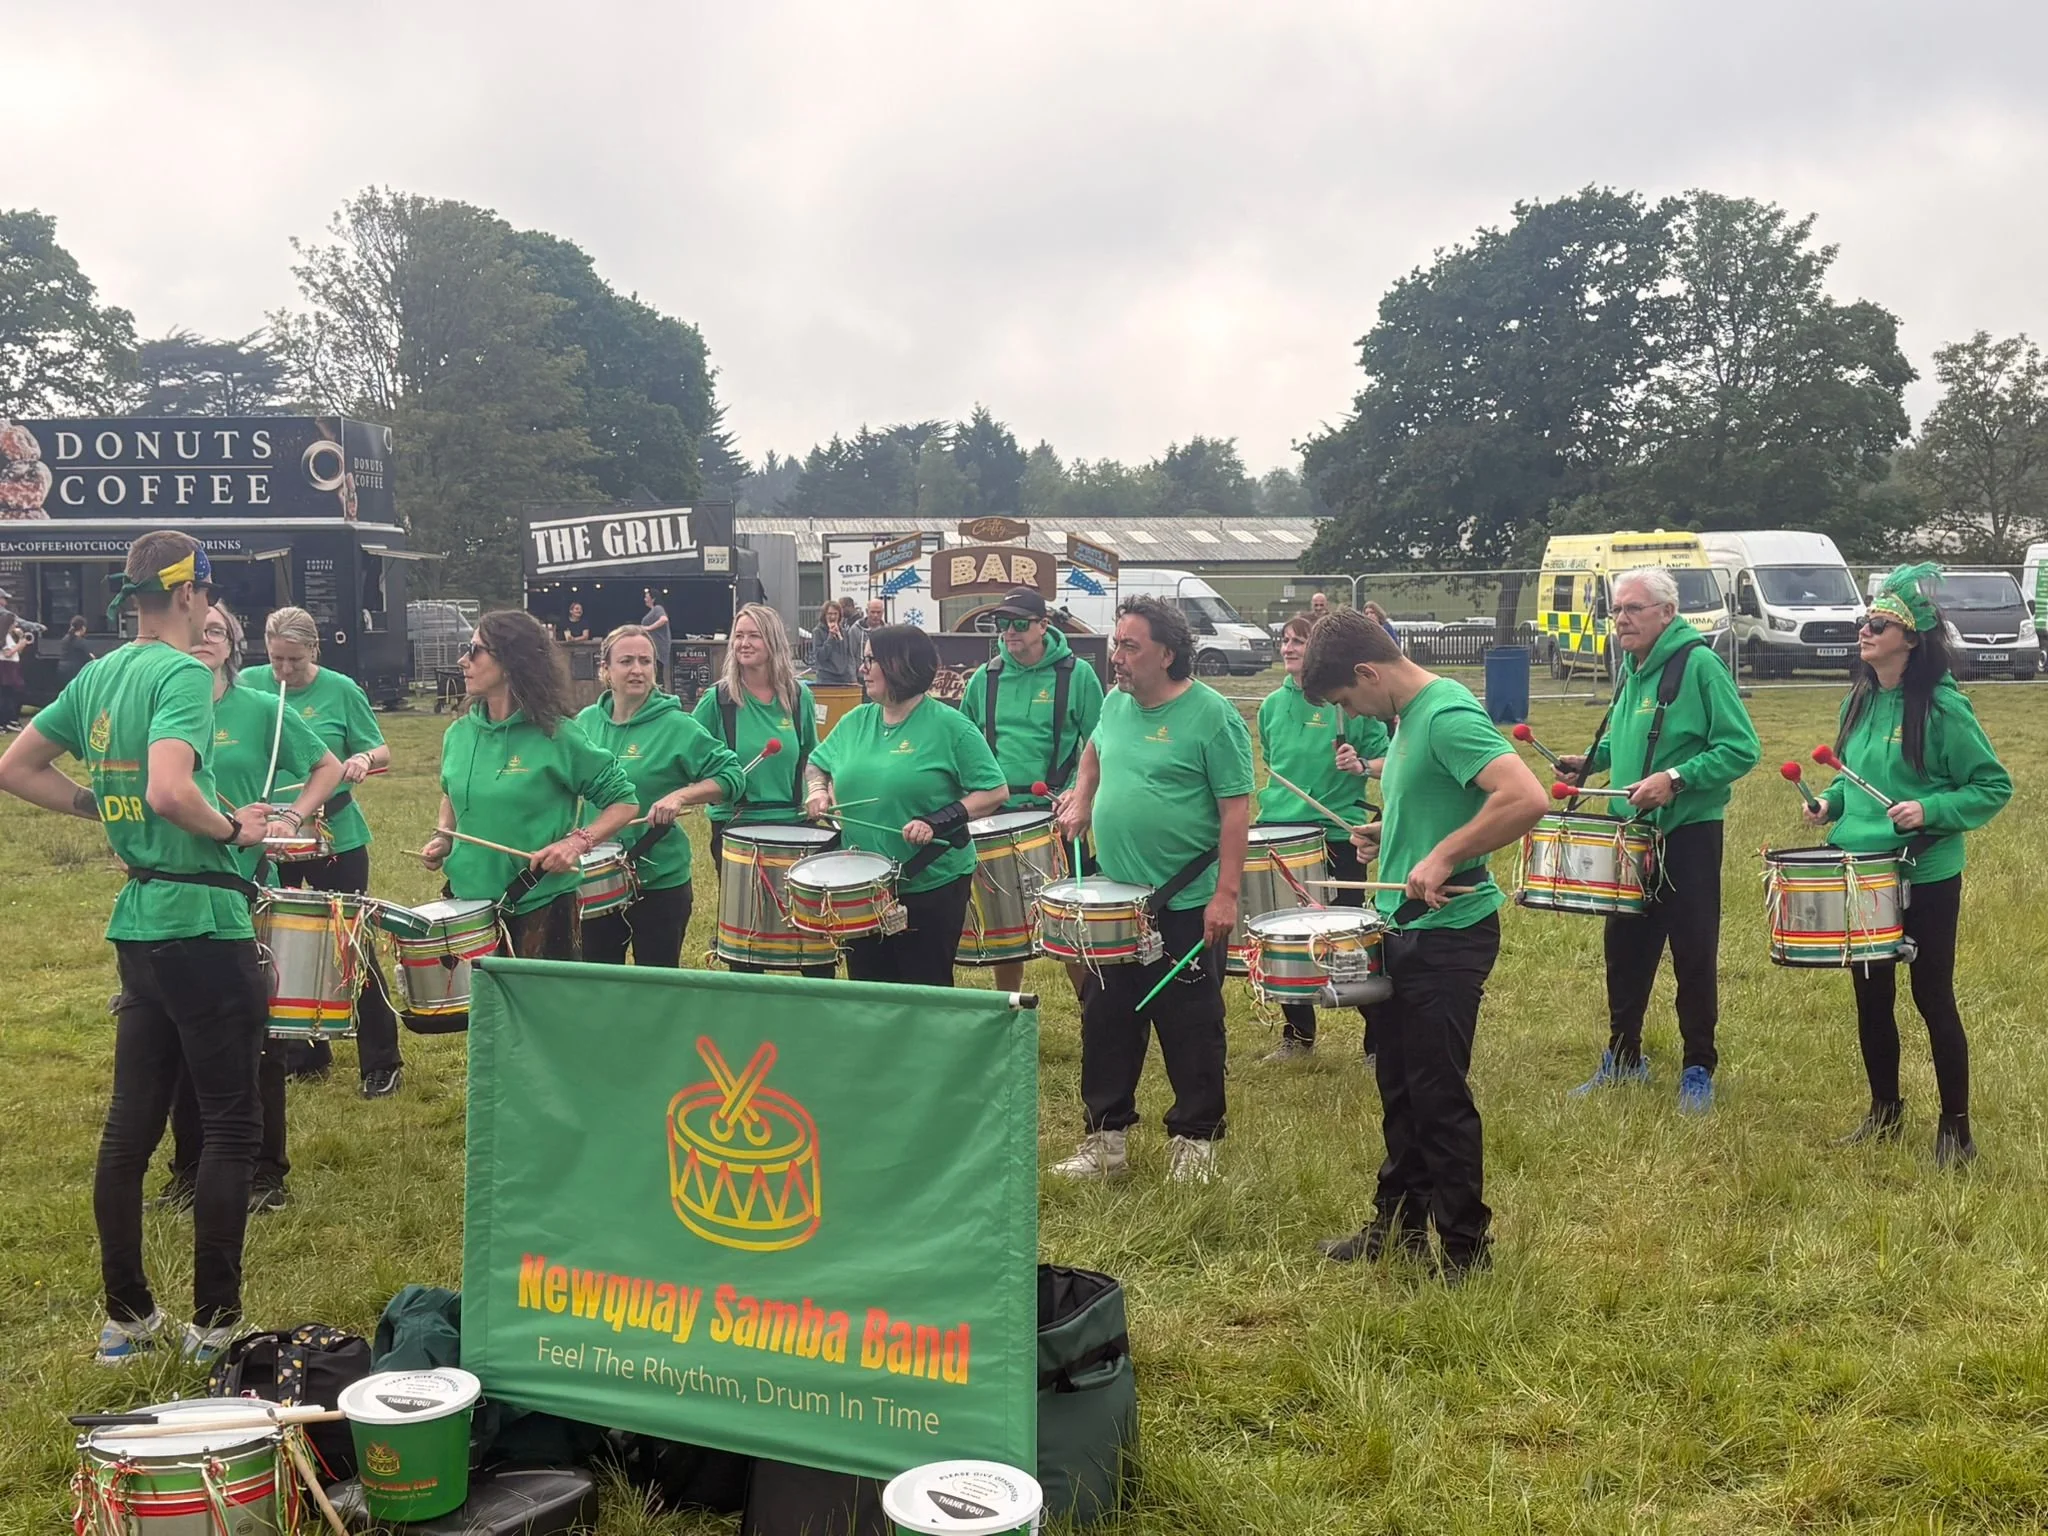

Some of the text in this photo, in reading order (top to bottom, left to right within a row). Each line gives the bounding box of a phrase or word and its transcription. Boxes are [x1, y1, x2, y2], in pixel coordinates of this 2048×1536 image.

[55, 430, 272, 460] DONUTS
[354, 457, 384, 472] DONUTS
[59, 474, 271, 505] COFFEE
[355, 474, 384, 489] COFFEE
[971, 519, 1007, 536] Crafty
[531, 515, 697, 565] THE GRILL
[838, 564, 868, 573] CRTS
[951, 554, 1038, 587] BAR
[97, 795, 145, 822] DER
[518, 1253, 970, 1385] Newquay Samba Band
[538, 1336, 939, 1435] Feel The Rhythm, Drum In Time
[387, 1396, 431, 1408] THANK YOU!
[939, 1472, 969, 1481] PLEASE
[938, 1495, 985, 1517] THANK YOU!
